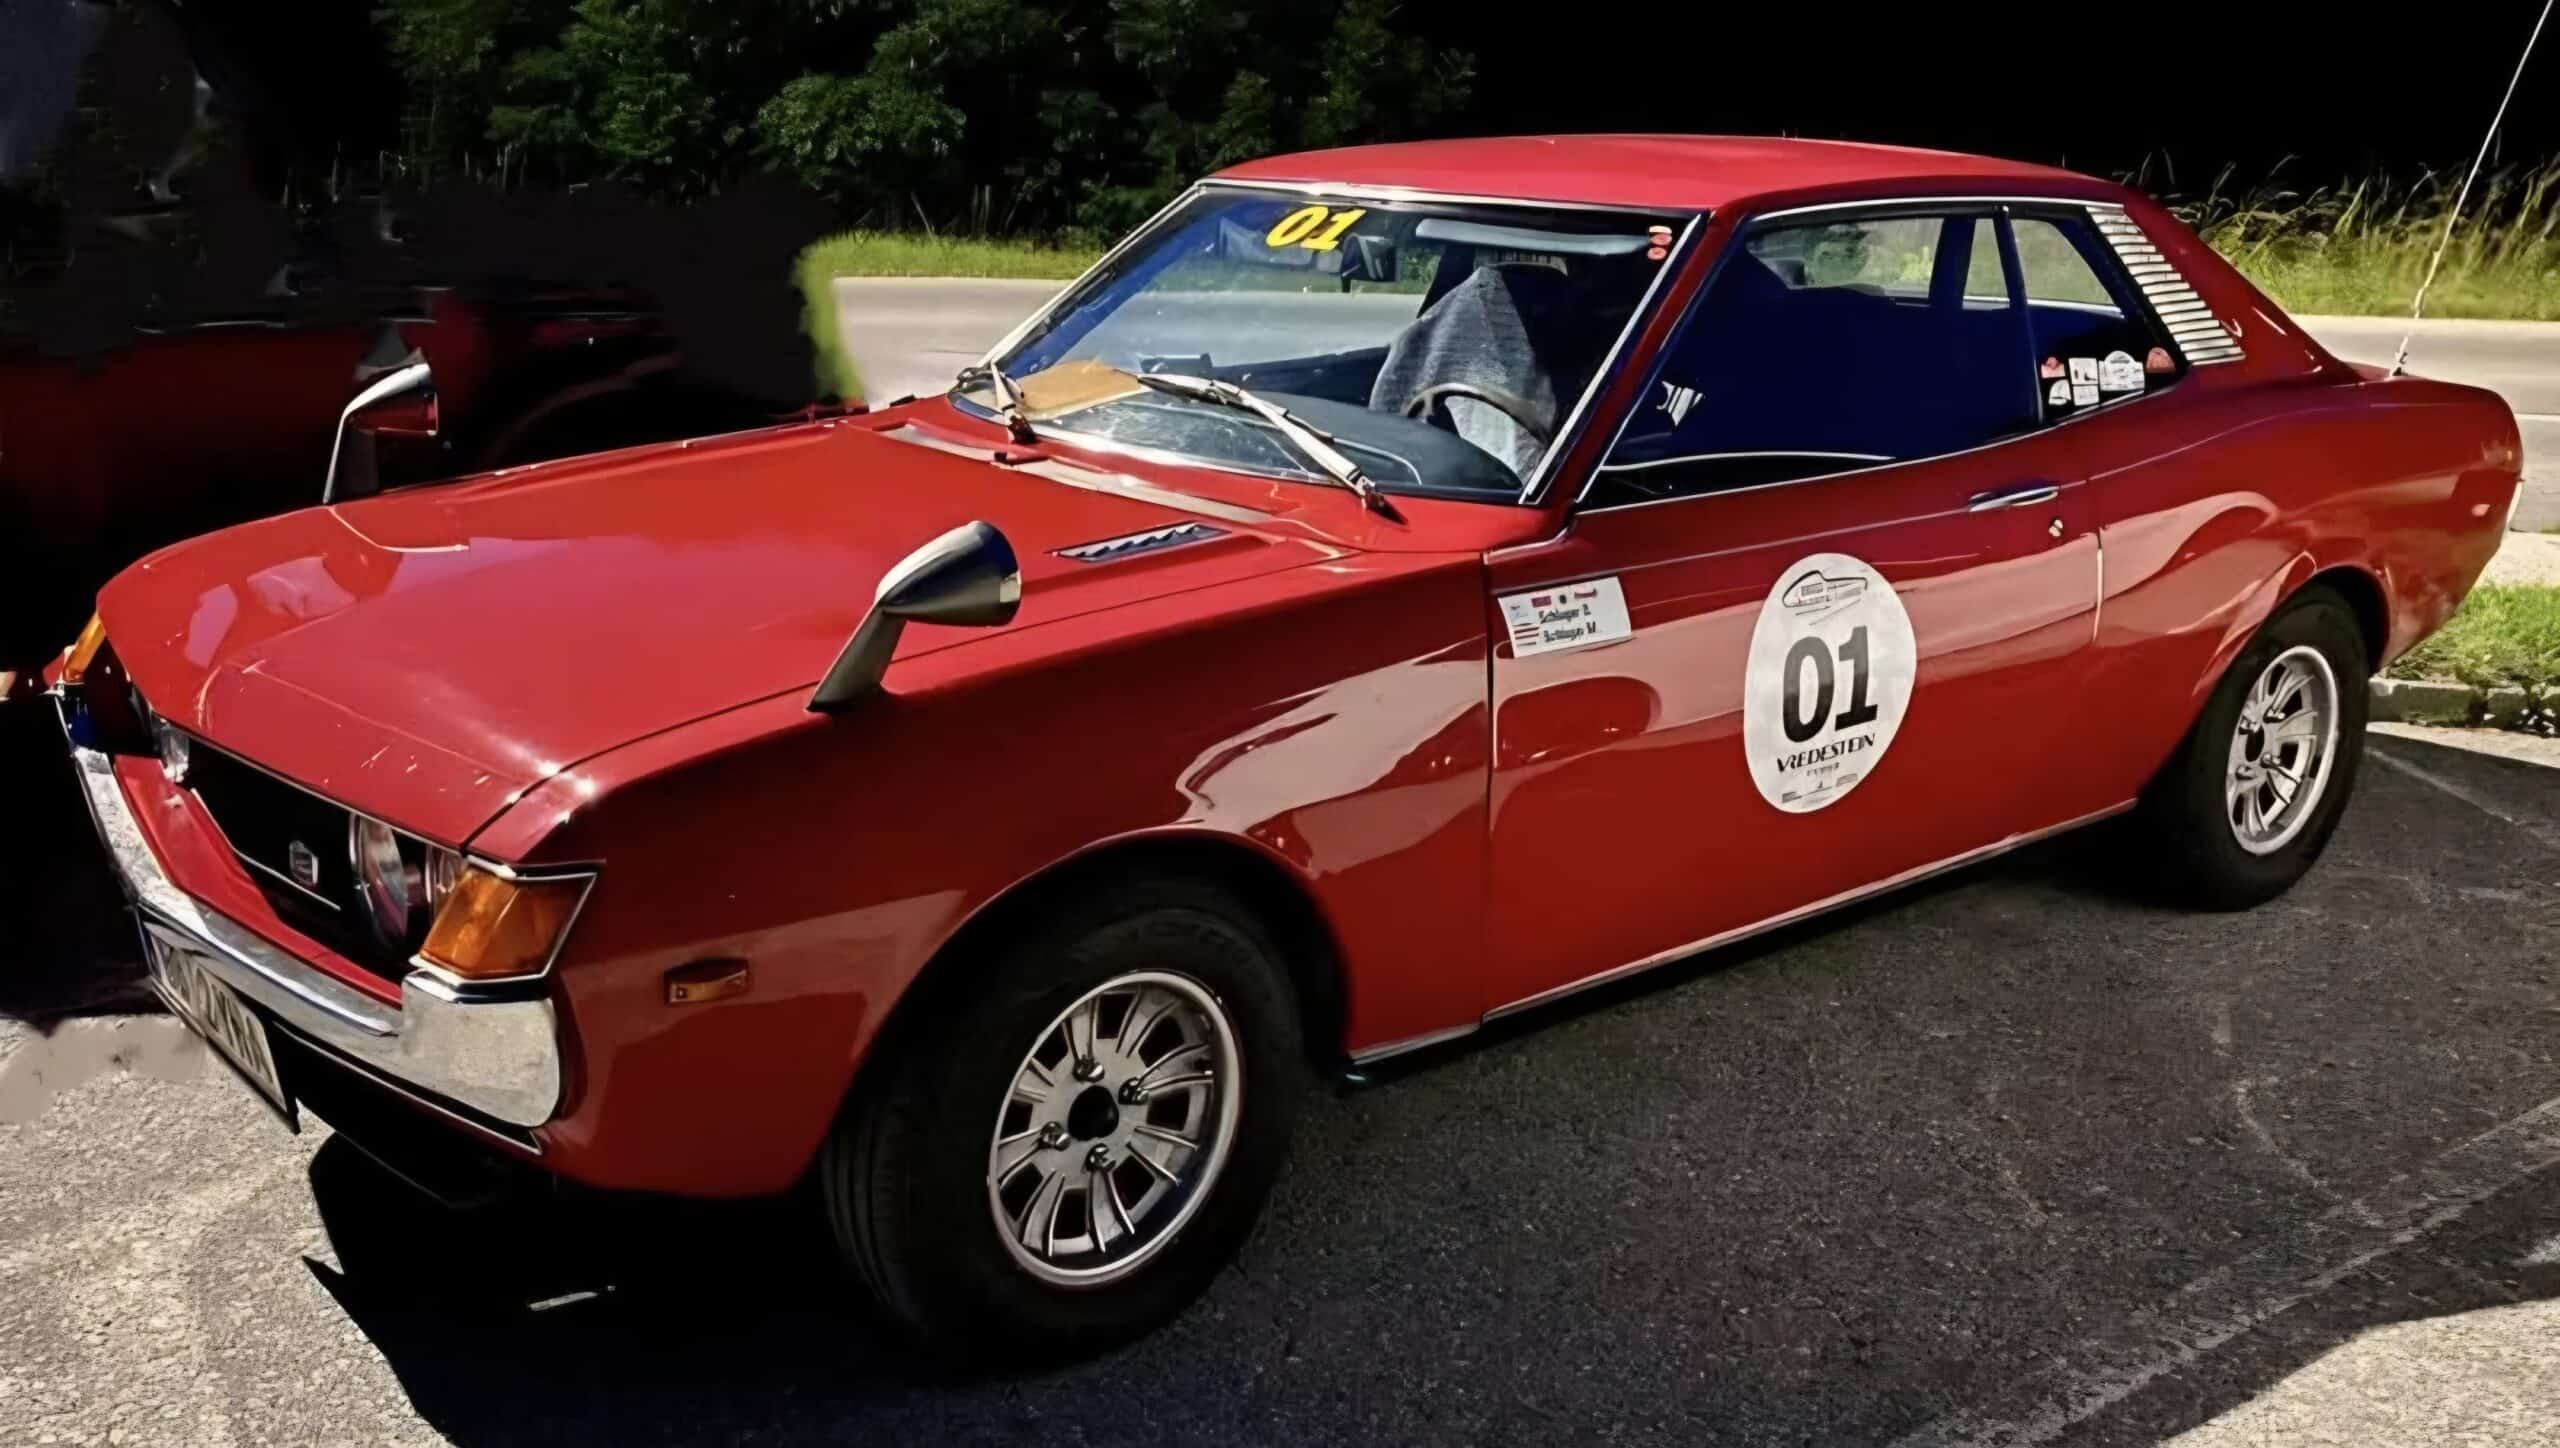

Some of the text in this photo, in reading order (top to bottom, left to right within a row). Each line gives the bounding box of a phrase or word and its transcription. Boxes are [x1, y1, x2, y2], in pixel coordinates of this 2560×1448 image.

[1265, 205, 1367, 251] 01
[1783, 624, 1878, 743] 01
[1776, 733, 1876, 773] VREDESTEIN
